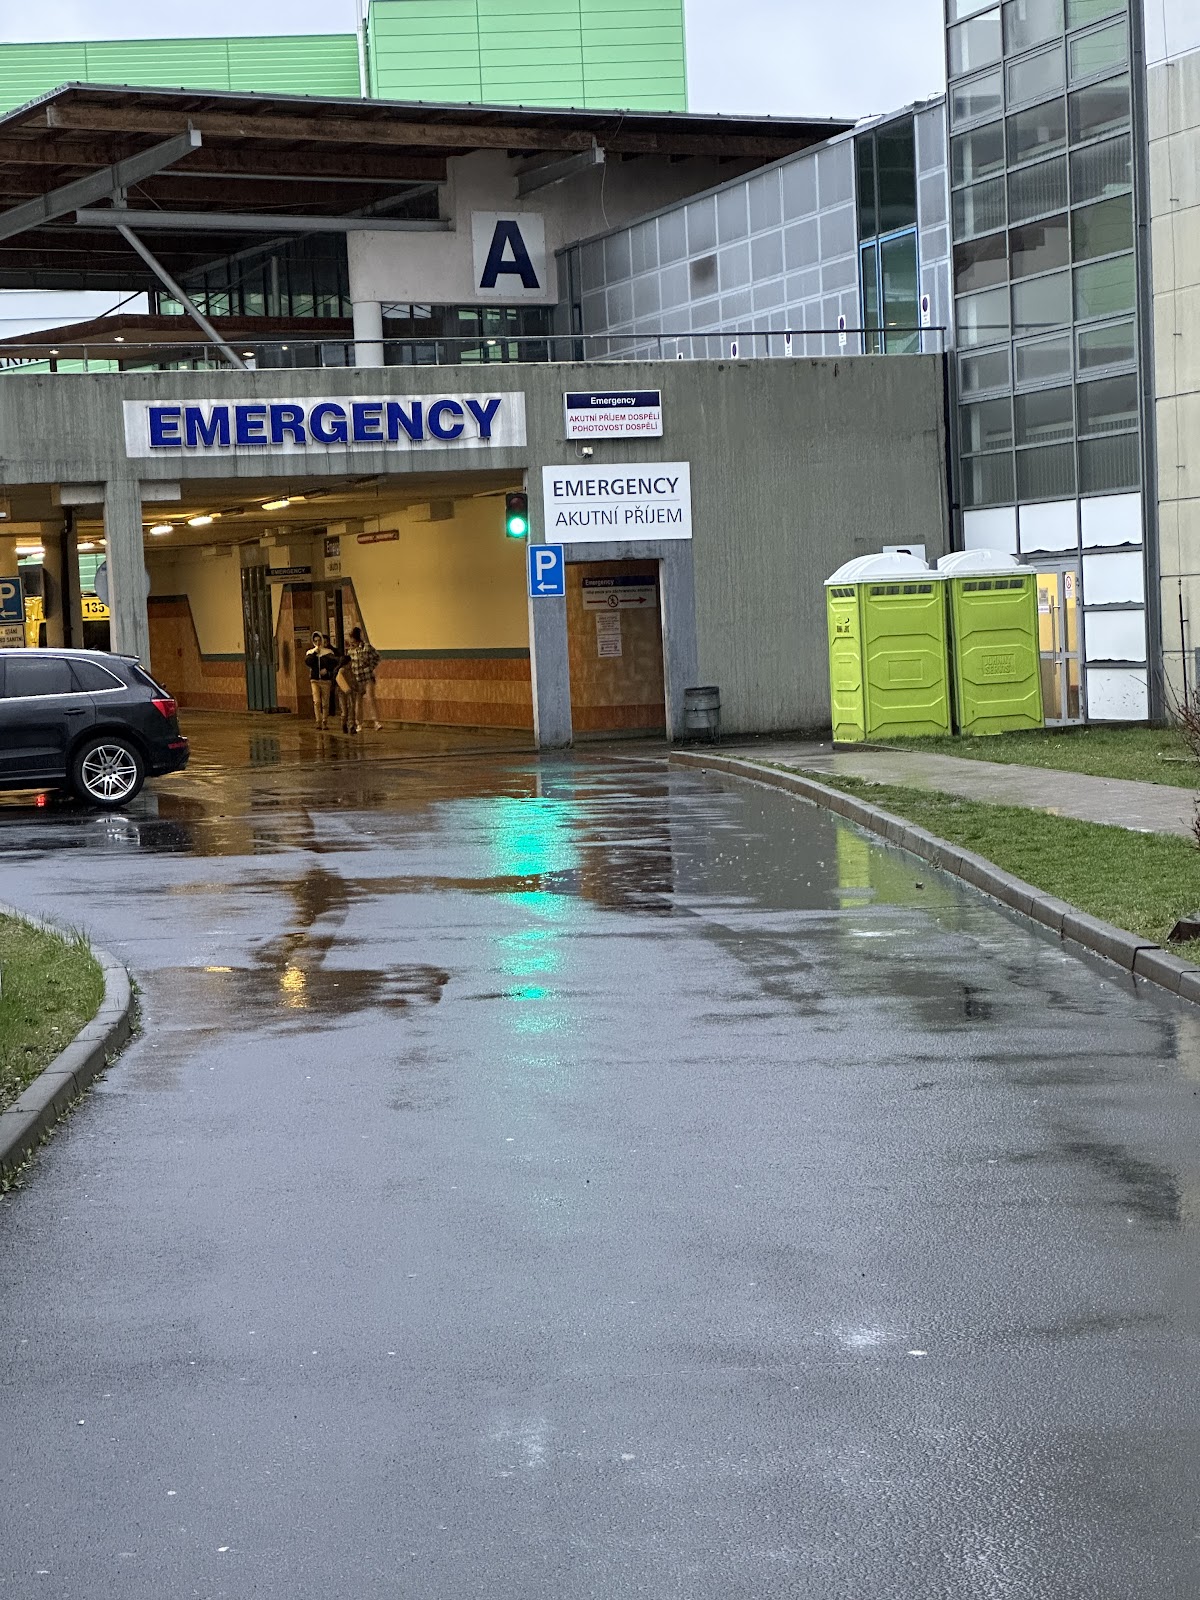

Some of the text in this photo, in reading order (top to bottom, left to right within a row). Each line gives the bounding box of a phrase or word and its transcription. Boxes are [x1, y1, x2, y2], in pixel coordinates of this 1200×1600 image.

[480, 220, 540, 288] A
[590, 396, 636, 406] Emergency
[148, 398, 502, 447] EMERGENCY
[569, 411, 660, 422] AKUTNÍ PŘÍJEM DOSPĚLÍ
[572, 422, 658, 432] POHOTOVOST DOSPĚLÍ
[553, 477, 679, 497] EMERGENCY
[555, 504, 682, 526] AKUTNÍ PŘÍJEM
[535, 550, 557, 581] P
